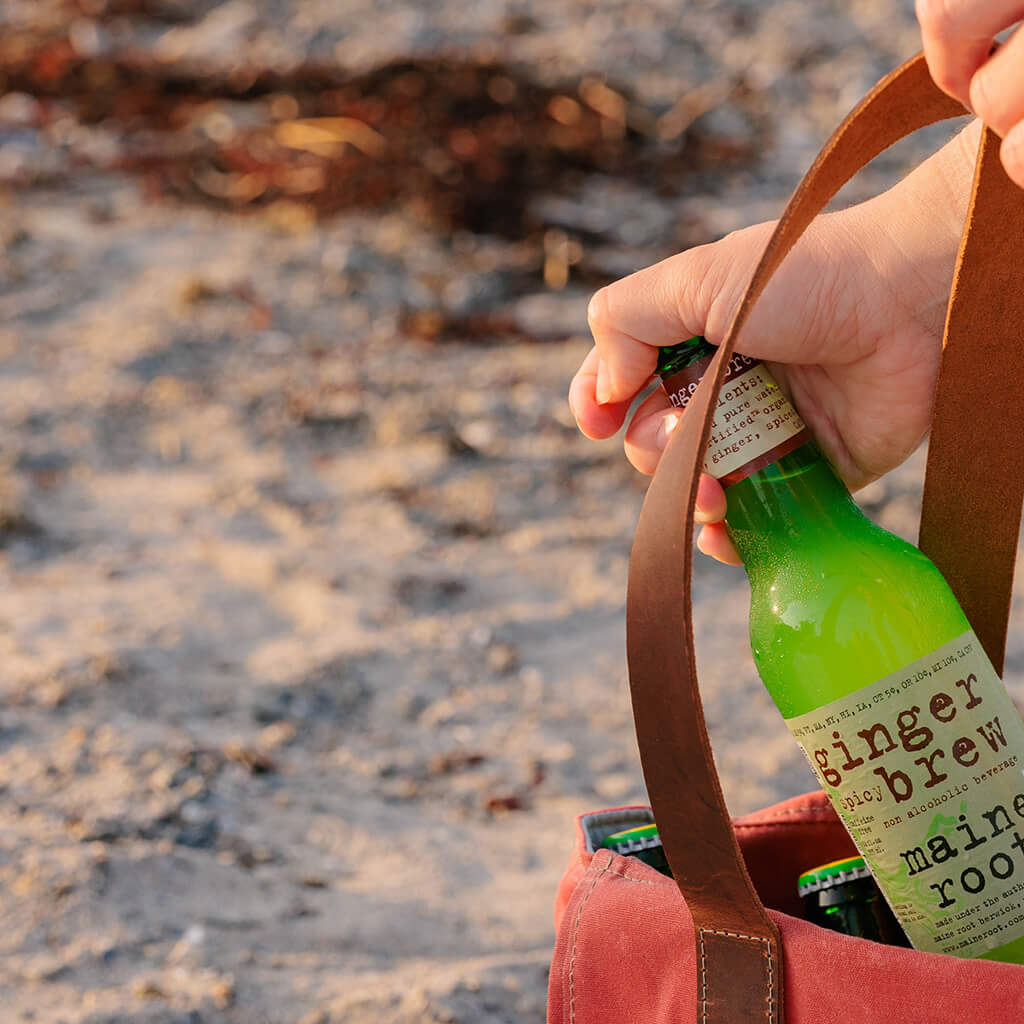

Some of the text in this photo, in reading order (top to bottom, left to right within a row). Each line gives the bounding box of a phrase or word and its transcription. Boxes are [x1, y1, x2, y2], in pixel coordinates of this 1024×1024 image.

[722, 401, 751, 422] pure
[711, 433, 761, 464] ginger,
[814, 673, 983, 787] ginger
[873, 716, 1008, 804] brew
[840, 785, 882, 812] spicy
[882, 755, 1019, 829] non alcoholic beverage
[955, 904, 981, 924] under
[983, 896, 1000, 909] the
[956, 921, 976, 936] root
